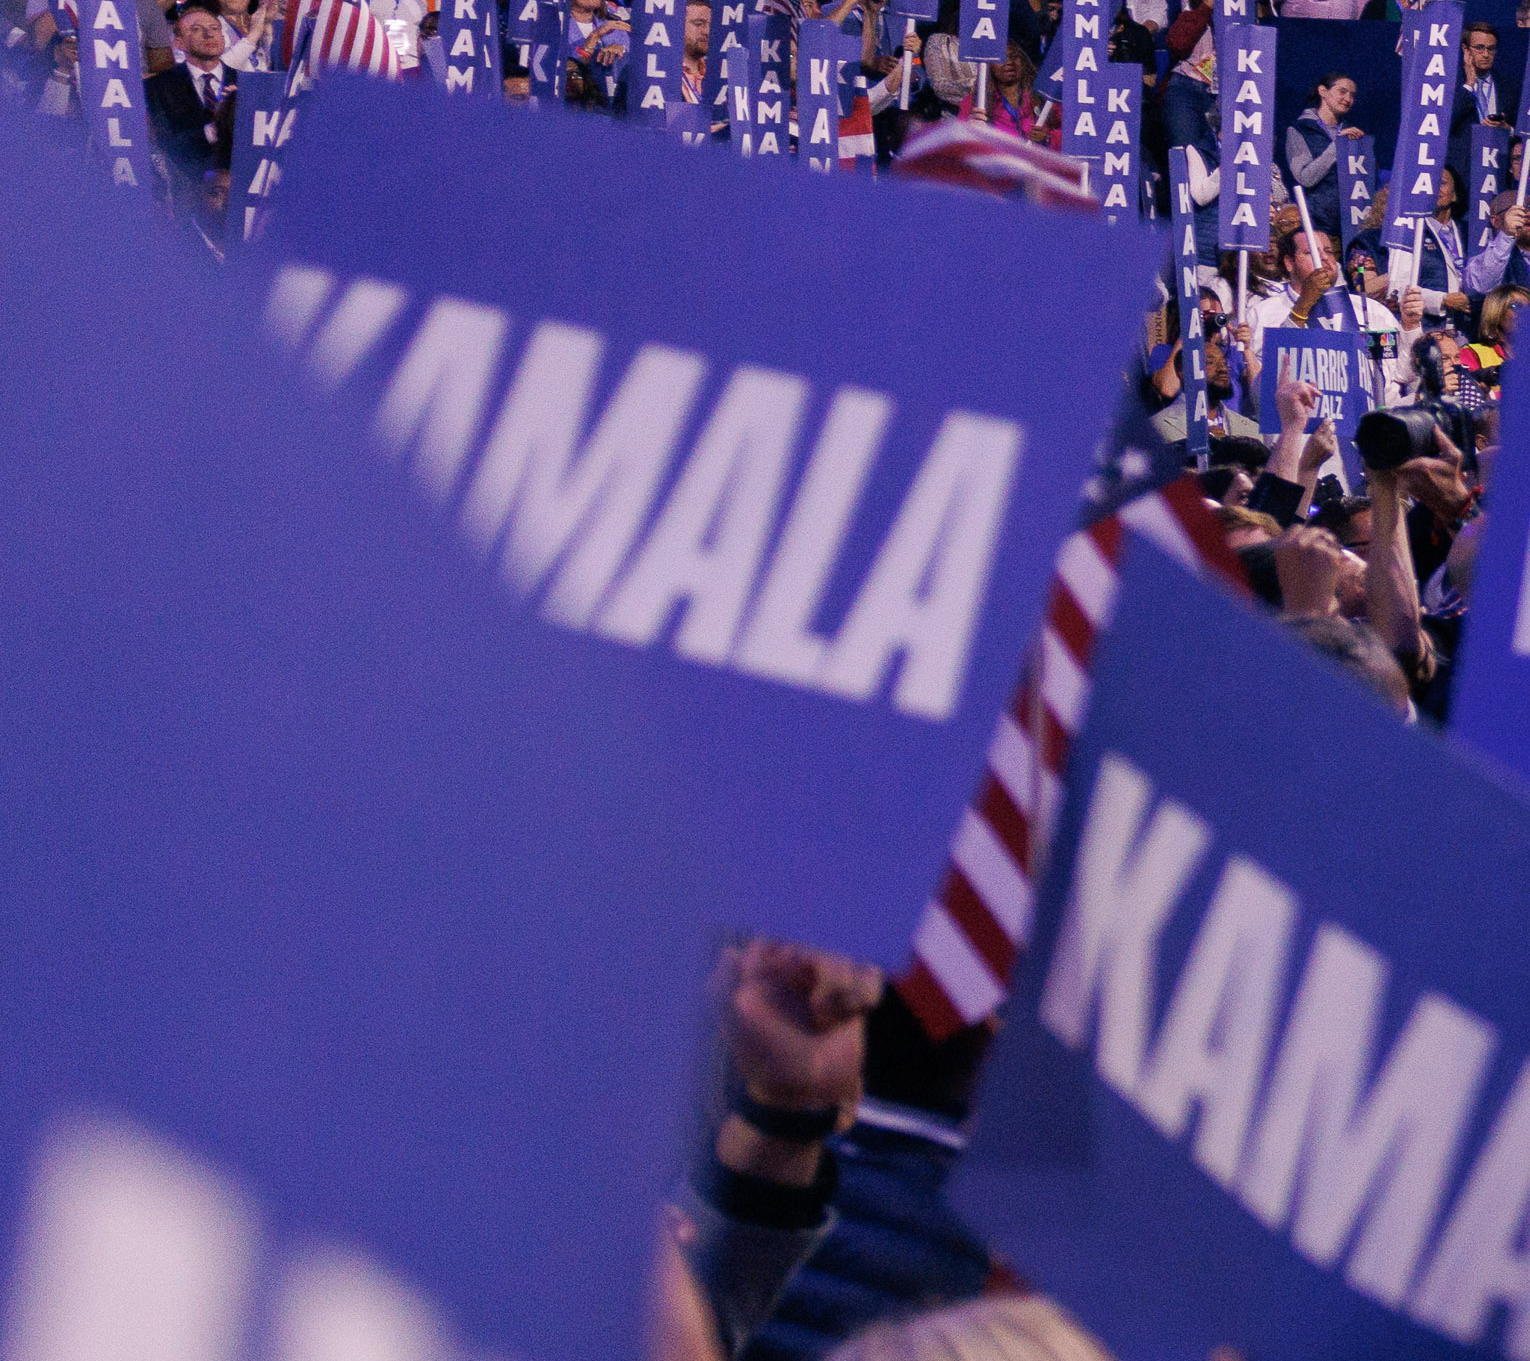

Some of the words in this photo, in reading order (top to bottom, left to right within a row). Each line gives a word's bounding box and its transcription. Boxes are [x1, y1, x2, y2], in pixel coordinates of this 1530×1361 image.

[757, 39, 784, 155] KAMA
[1103, 88, 1130, 208] KAMA
[1230, 49, 1264, 228] KAMALA
[1411, 23, 1450, 196] KAMALA
[1348, 155, 1371, 226] KAM
[1178, 182, 1209, 422] KAMALA
[1277, 346, 1349, 394] HARRIS
